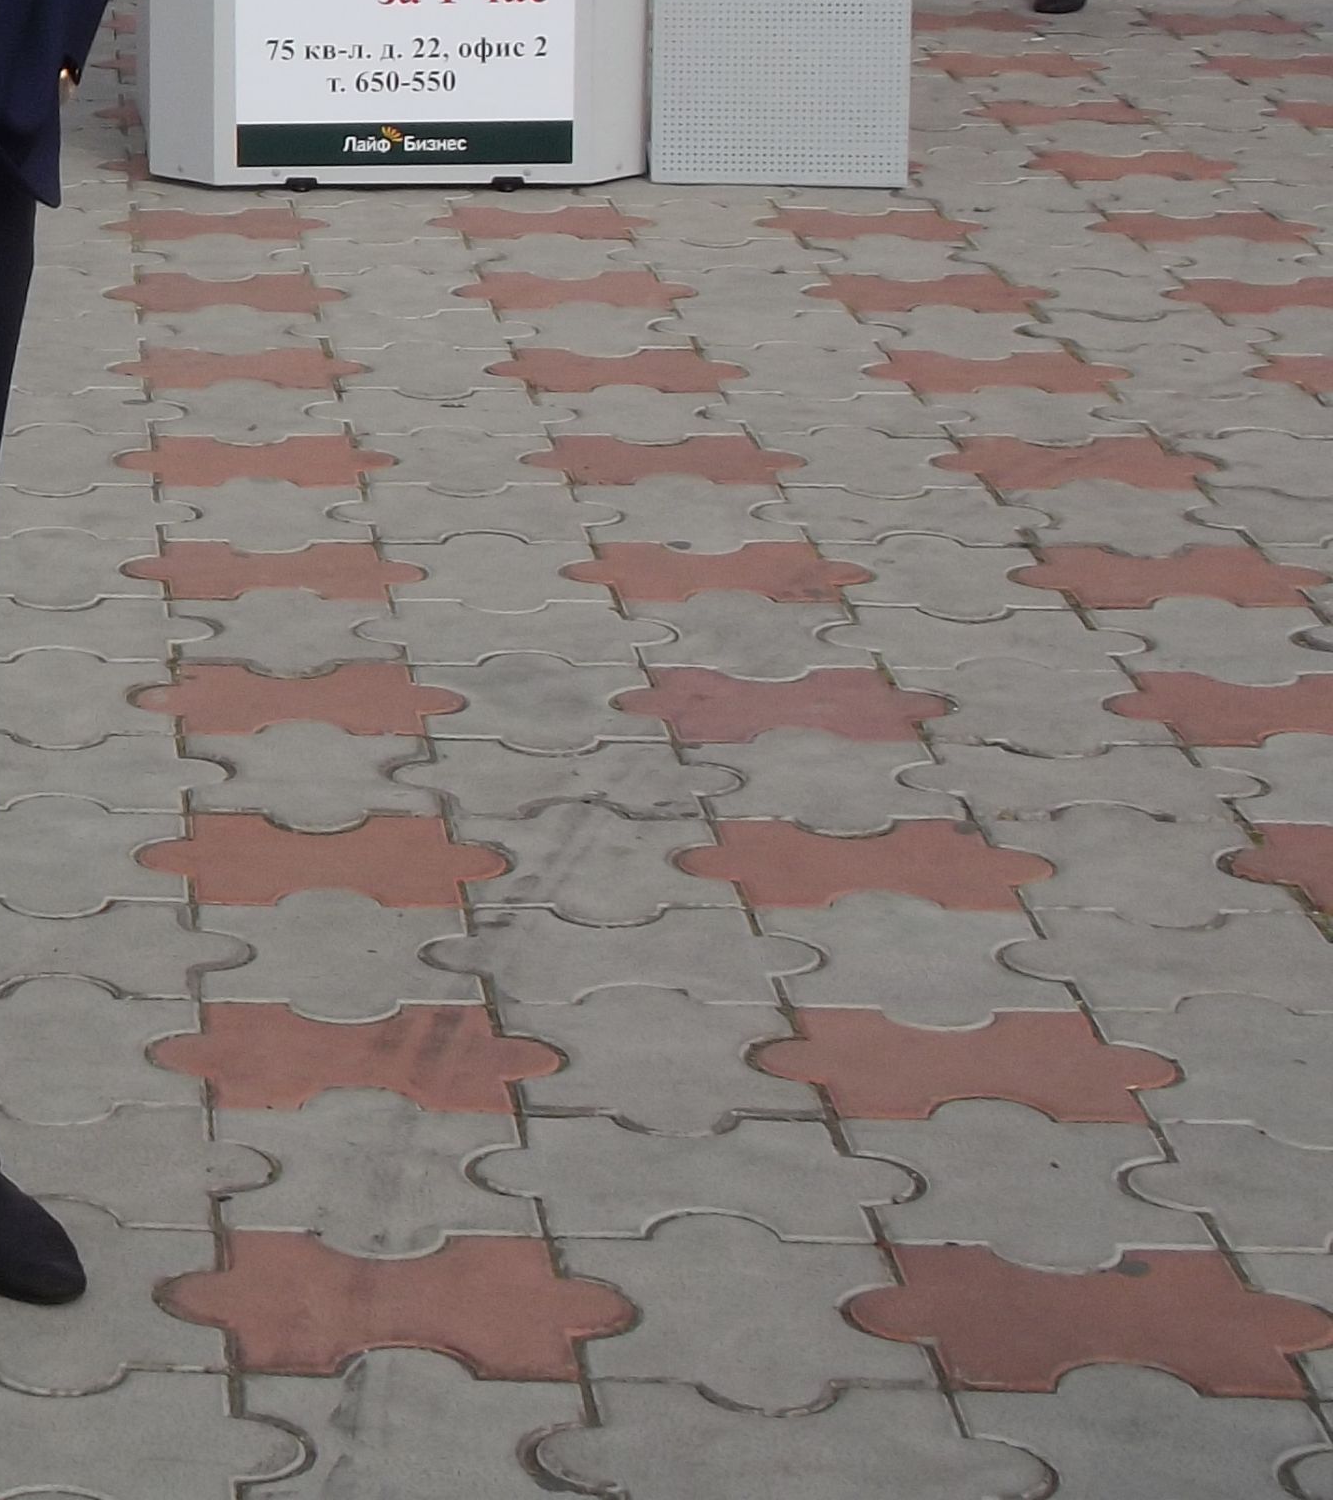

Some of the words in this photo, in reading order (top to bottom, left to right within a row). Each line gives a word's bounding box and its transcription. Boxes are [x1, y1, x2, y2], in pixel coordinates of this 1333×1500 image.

[265, 38, 295, 61] 75
[303, 43, 372, 60] кв-л.
[379, 43, 403, 61] д.
[412, 37, 449, 61] 22,
[458, 37, 526, 63] офис
[533, 36, 548, 57] 2
[326, 77, 346, 93] т.
[355, 70, 457, 93] 650-550
[342, 135, 392, 153] Лайф
[403, 135, 468, 151] Бизнес
